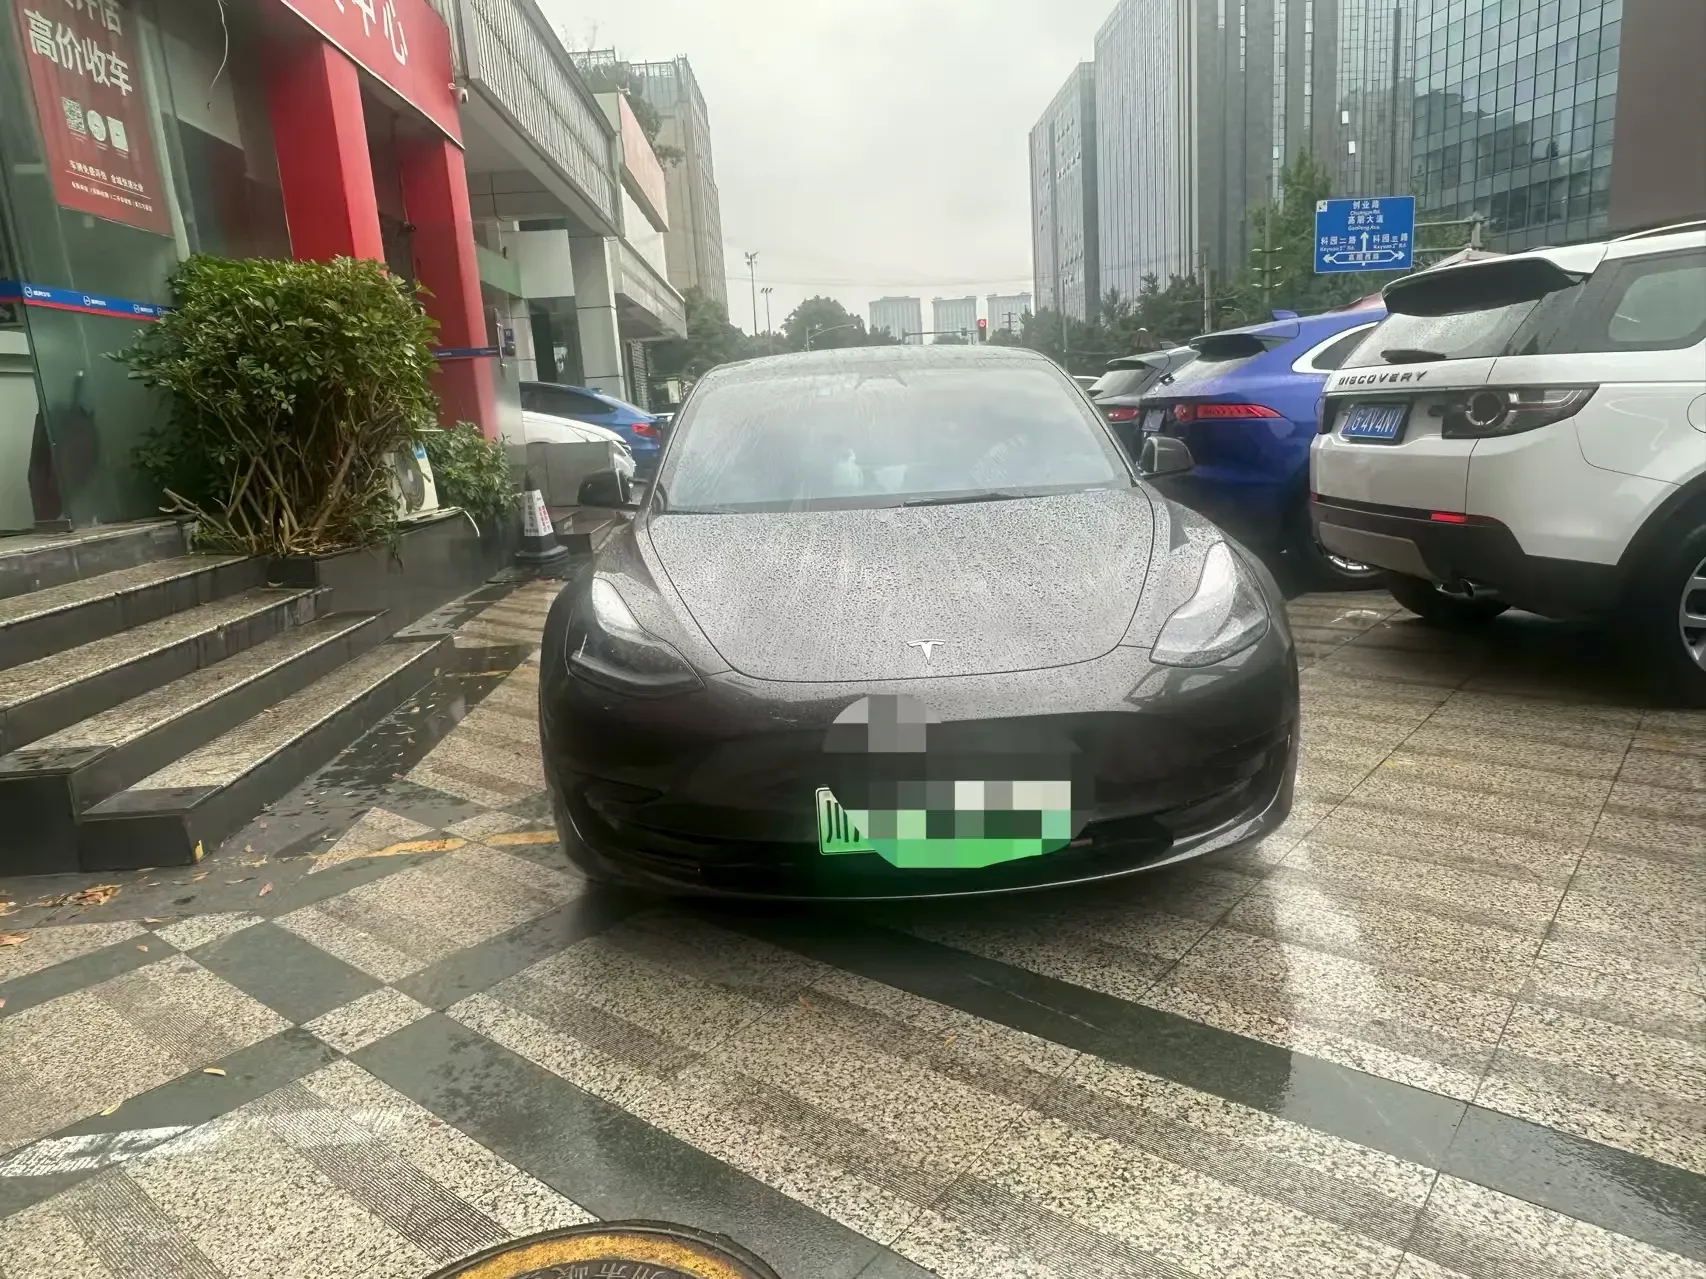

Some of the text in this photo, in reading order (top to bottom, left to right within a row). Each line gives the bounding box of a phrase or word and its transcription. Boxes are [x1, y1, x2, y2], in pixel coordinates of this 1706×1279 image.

[23, 8, 133, 96] 高价收车
[1352, 200, 1380, 210] 创业路
[1320, 236, 1357, 246] 科园二路
[1372, 232, 1409, 243] 科园三路
[1338, 370, 1429, 386] DISCOVERY
